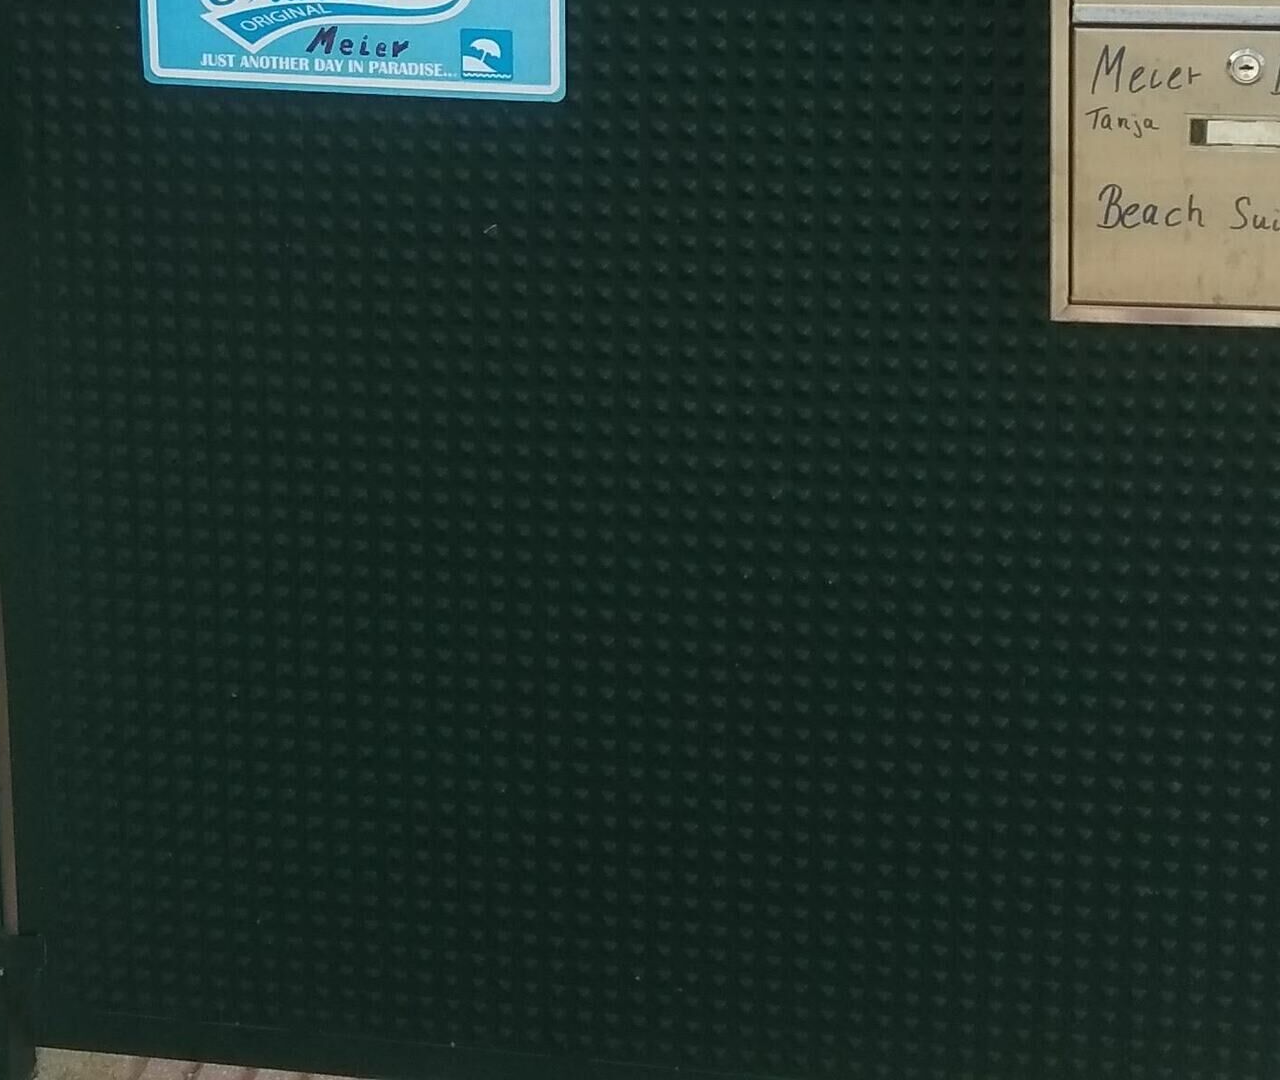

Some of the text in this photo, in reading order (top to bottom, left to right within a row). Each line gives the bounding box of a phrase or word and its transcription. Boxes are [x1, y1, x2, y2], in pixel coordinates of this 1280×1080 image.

[240, 3, 333, 33] ORIGINAL
[306, 26, 411, 58] Meier
[200, 53, 236, 68] JUST
[240, 54, 310, 71] ANOTHER
[314, 58, 344, 73] DAY
[348, 60, 364, 74] IN
[1091, 44, 1202, 95] Meier
[1085, 107, 1160, 138] Tanja
[1097, 183, 1205, 230] Beach
